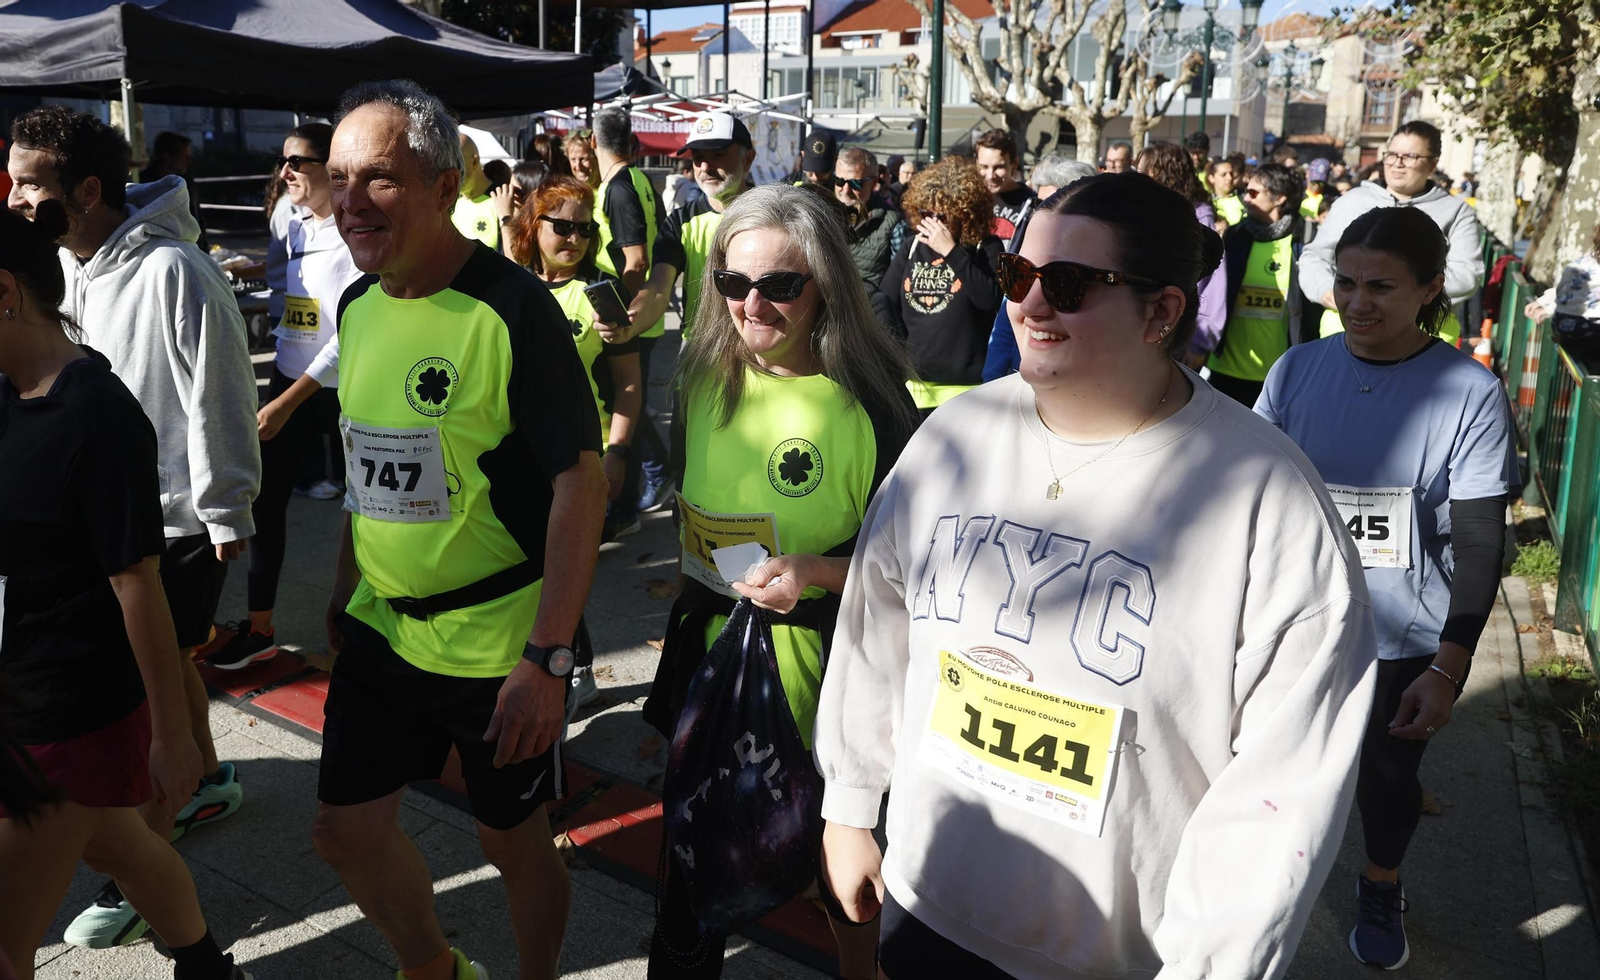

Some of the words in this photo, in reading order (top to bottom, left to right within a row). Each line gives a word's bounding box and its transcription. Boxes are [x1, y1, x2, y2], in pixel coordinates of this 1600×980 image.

[1245, 295, 1282, 309] 1216
[371, 432, 400, 440] ESCLEROSE
[360, 457, 422, 492] 747
[1342, 489, 1374, 497] ESCLEROSE
[913, 514, 1157, 686] NYC
[947, 653, 959, 661] EU
[986, 676, 1008, 689] POLA
[1009, 684, 1061, 704] ESCLEROSE
[983, 696, 1003, 707] Antia
[960, 702, 1094, 787] 1141
